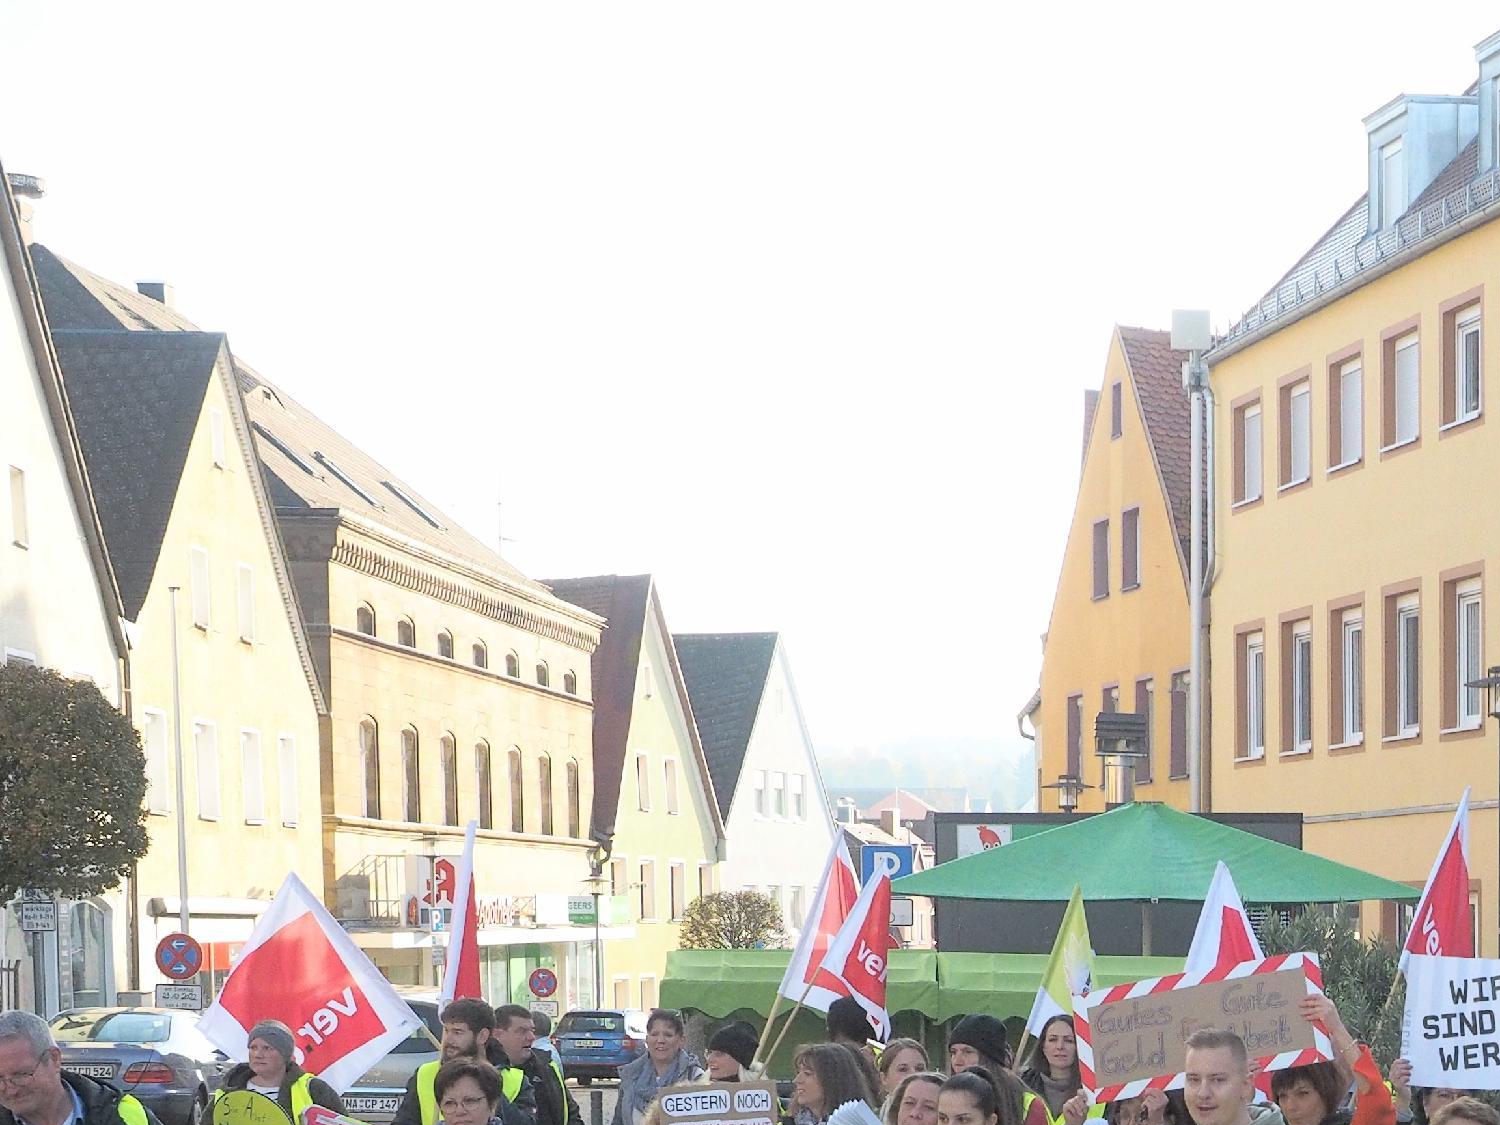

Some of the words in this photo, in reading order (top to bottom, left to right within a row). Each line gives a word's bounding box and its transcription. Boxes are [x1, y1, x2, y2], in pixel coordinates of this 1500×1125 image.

[1096, 1001, 1173, 1034] Gutes
[1422, 1009, 1496, 1040] SIND
[93, 1067, 112, 1079] 524
[364, 1100, 377, 1110] CP
[665, 1095, 728, 1112] GESTERN
[737, 1093, 769, 1109] NOCH
